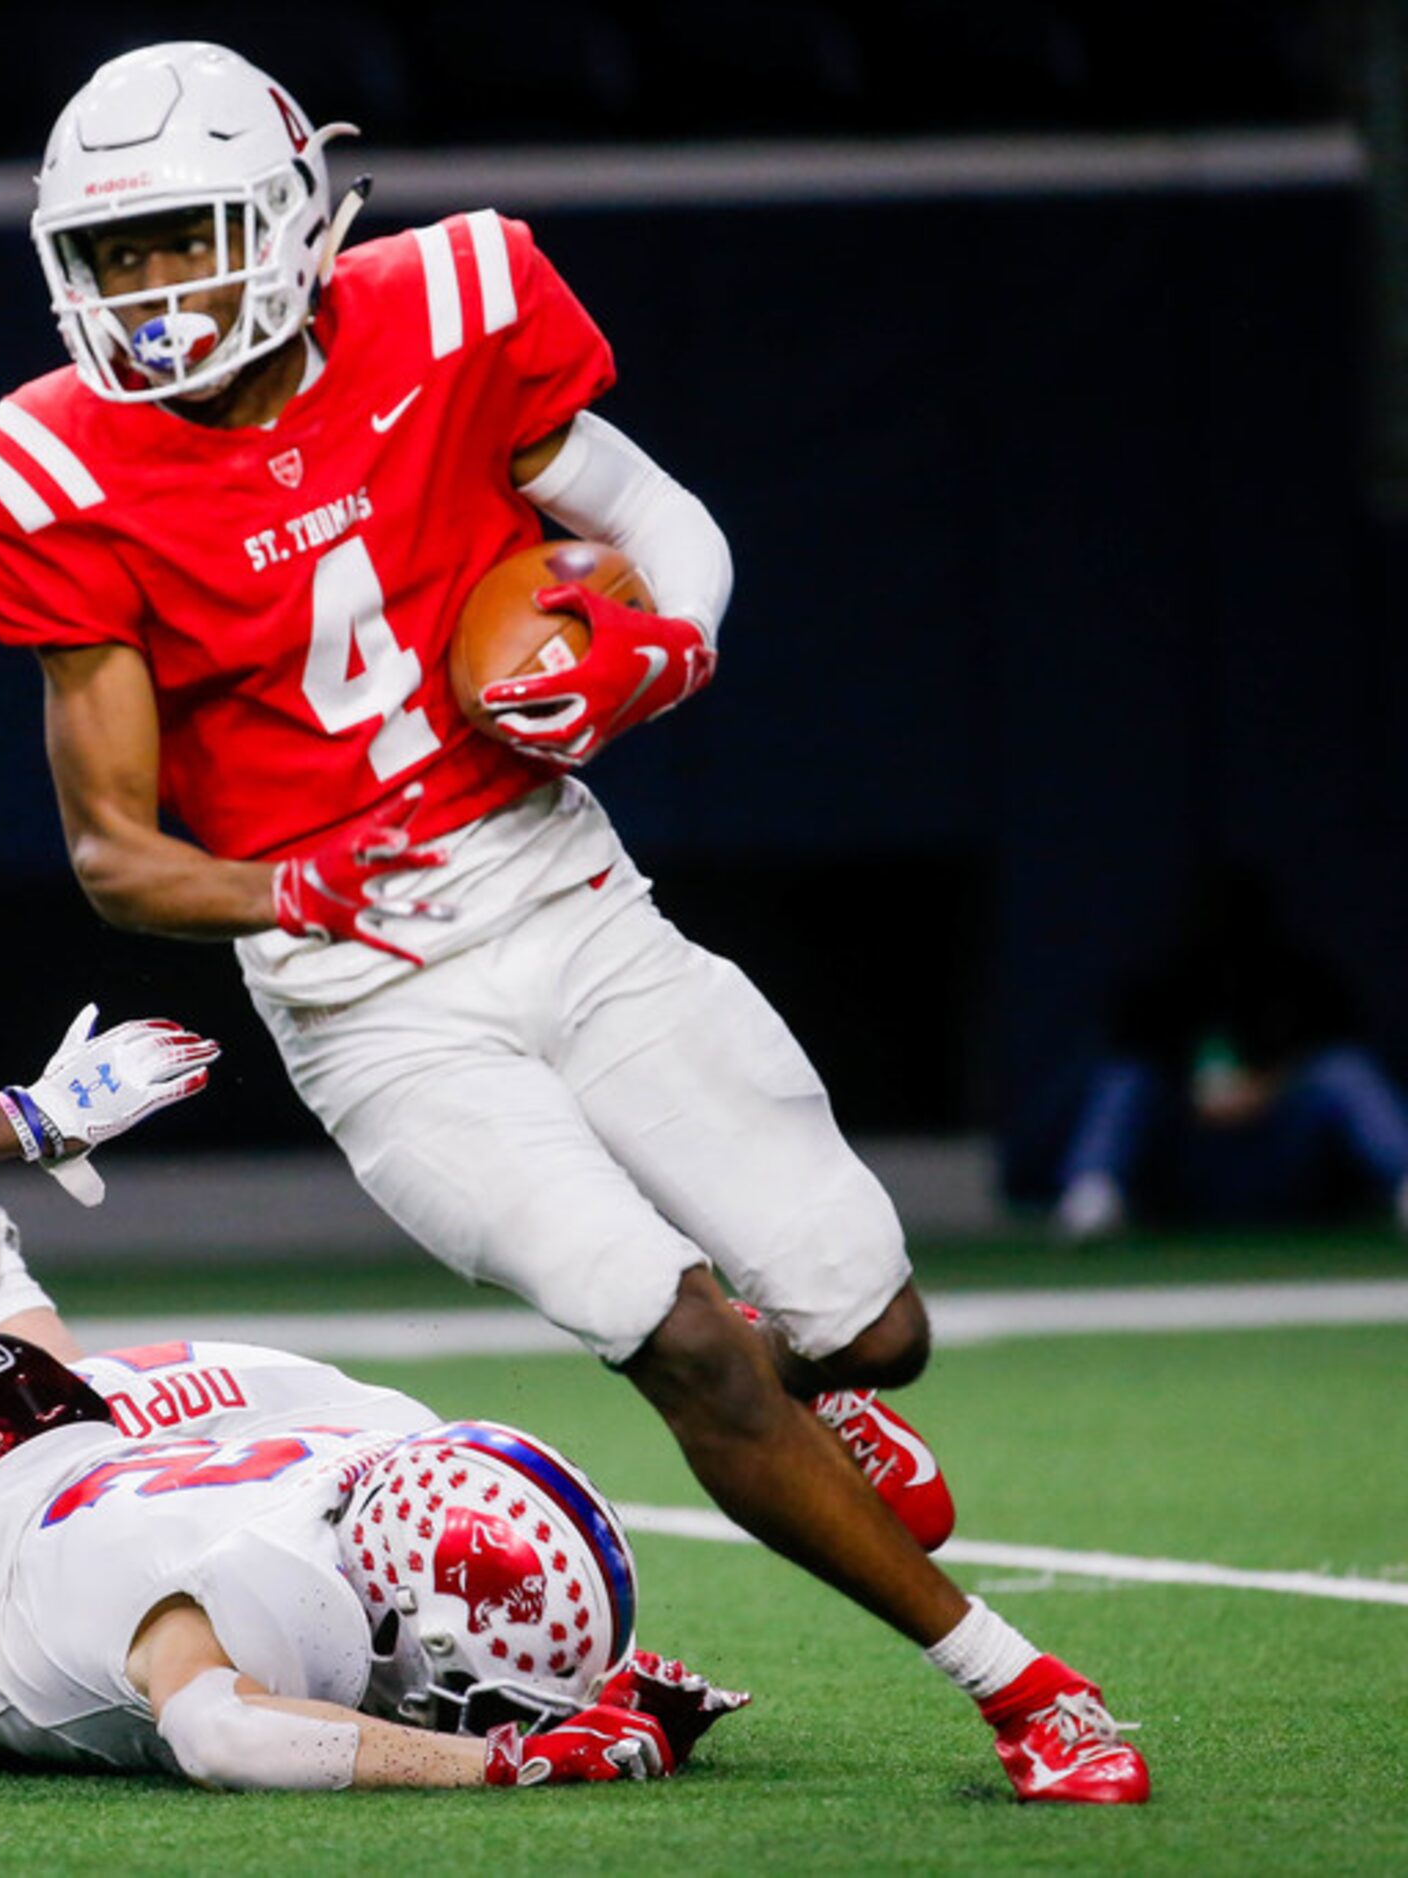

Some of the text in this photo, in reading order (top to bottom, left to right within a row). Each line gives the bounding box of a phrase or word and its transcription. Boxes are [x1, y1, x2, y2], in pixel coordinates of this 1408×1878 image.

[244, 486, 374, 572] ST. THOMAS
[302, 535, 442, 783] 4
